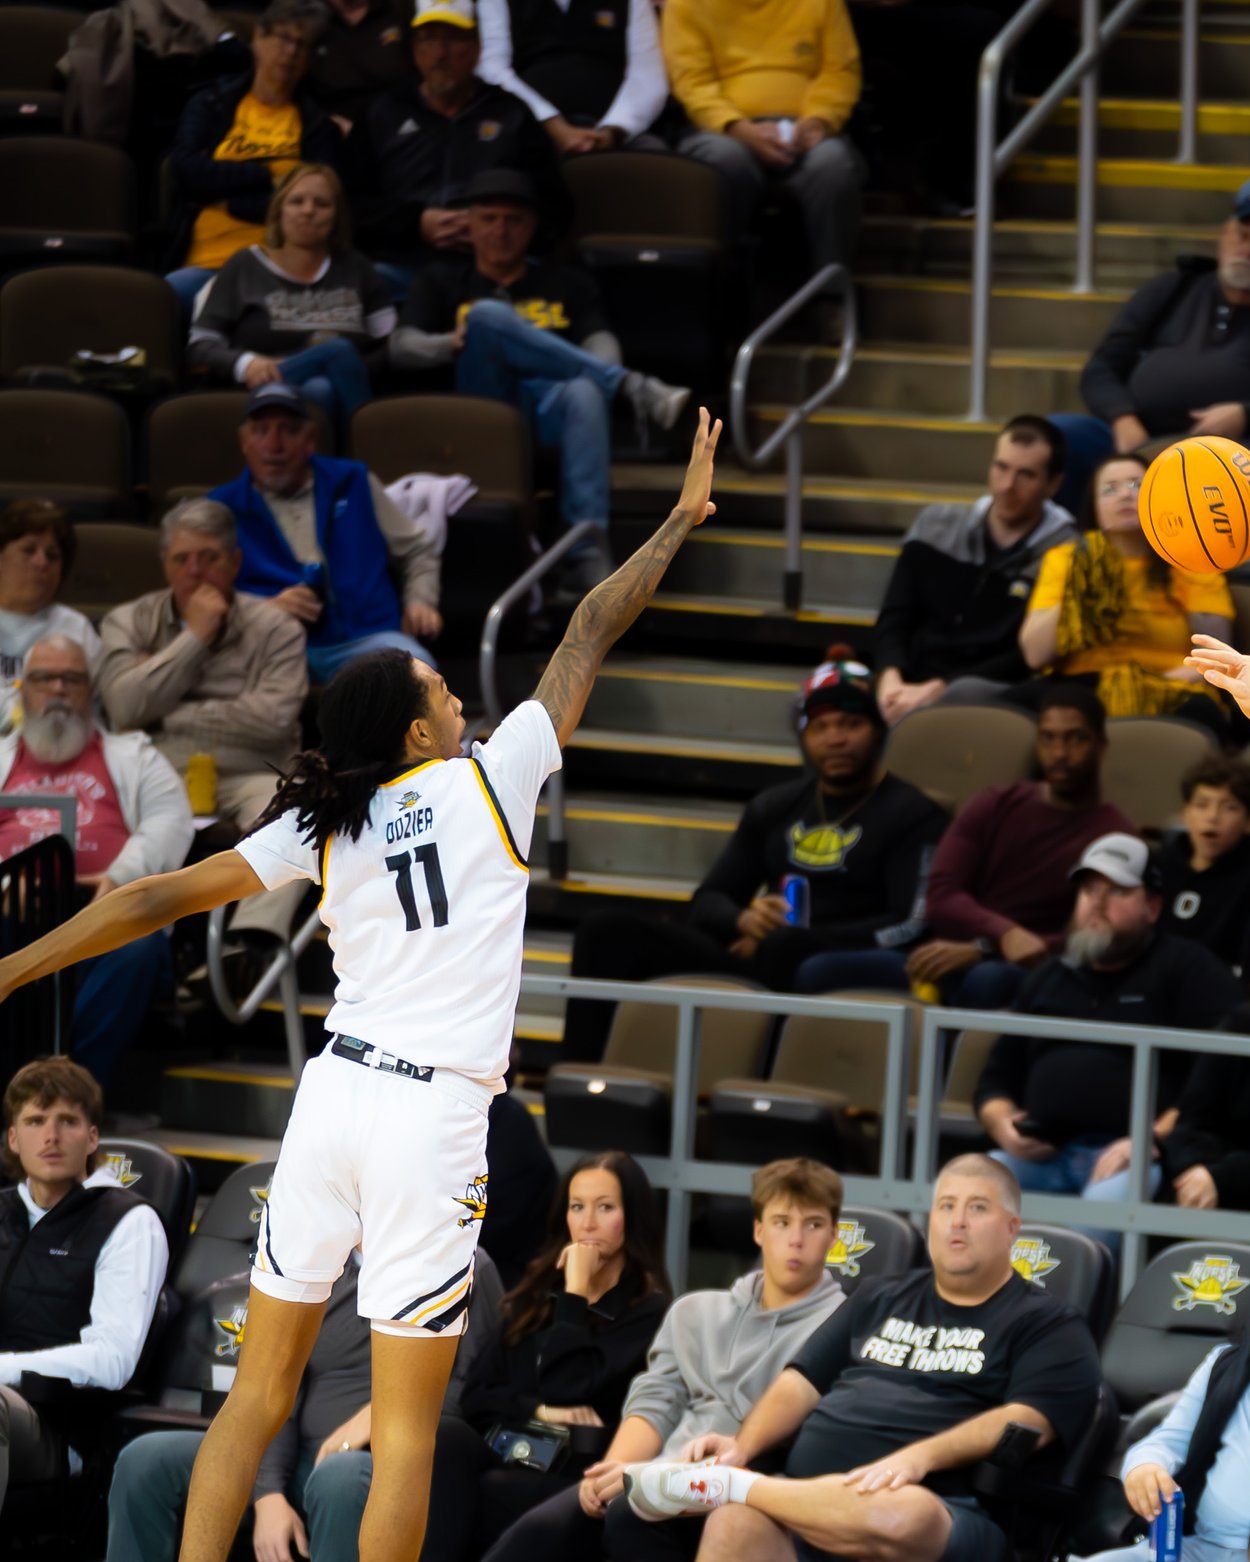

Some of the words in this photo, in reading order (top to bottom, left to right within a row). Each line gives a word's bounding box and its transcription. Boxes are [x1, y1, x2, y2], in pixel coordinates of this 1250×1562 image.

[1202, 486, 1233, 534] EVO
[386, 806, 433, 844] DOZIER
[385, 842, 449, 932] 11
[881, 1317, 938, 1348] MAKE
[935, 1326, 986, 1350] YOUR
[860, 1335, 912, 1367] FREE
[907, 1346, 986, 1375] THROWS
